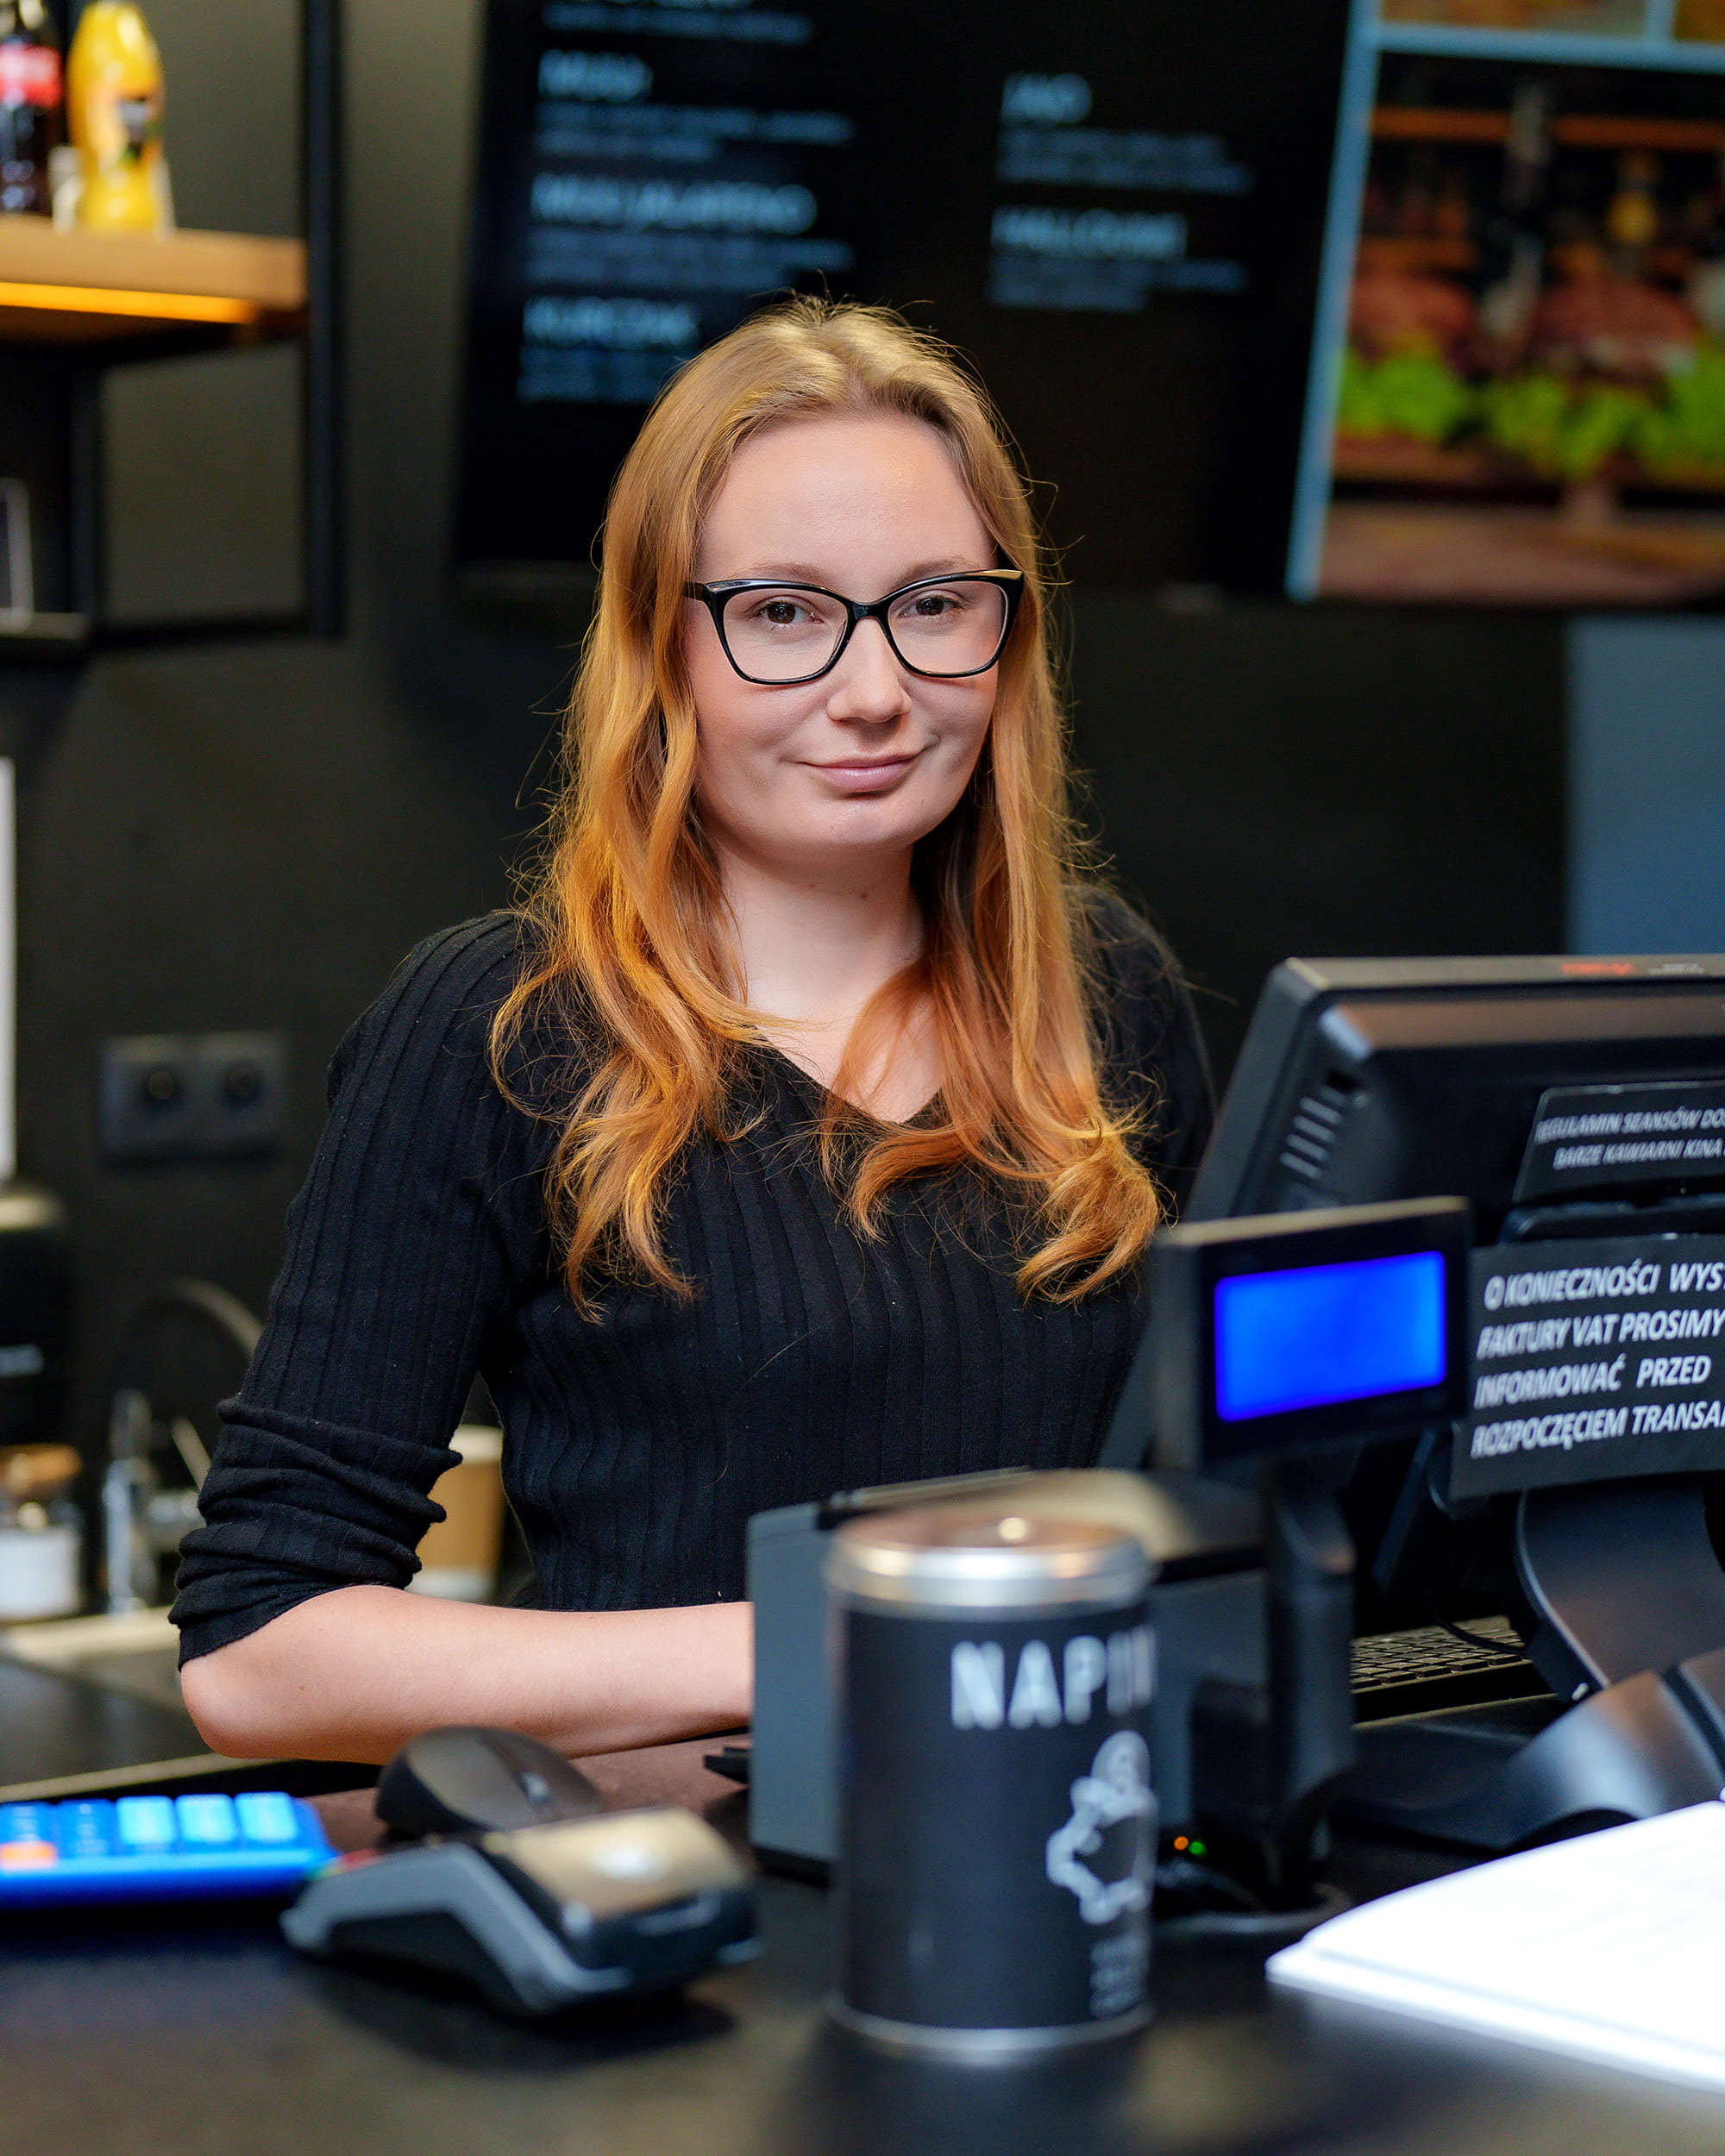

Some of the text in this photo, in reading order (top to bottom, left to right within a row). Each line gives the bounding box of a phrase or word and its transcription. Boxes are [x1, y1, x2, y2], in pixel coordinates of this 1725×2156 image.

[1484, 1257, 1725, 1311] O KONIECZNOŚCI WYS
[1477, 1308, 1725, 1361] FAKTURY VAT PROSIMY
[1474, 1352, 1712, 1410] INFORMOWAĆ PRZED
[1471, 1401, 1725, 1460] ROZPOCZĘCIEM TRANSA
